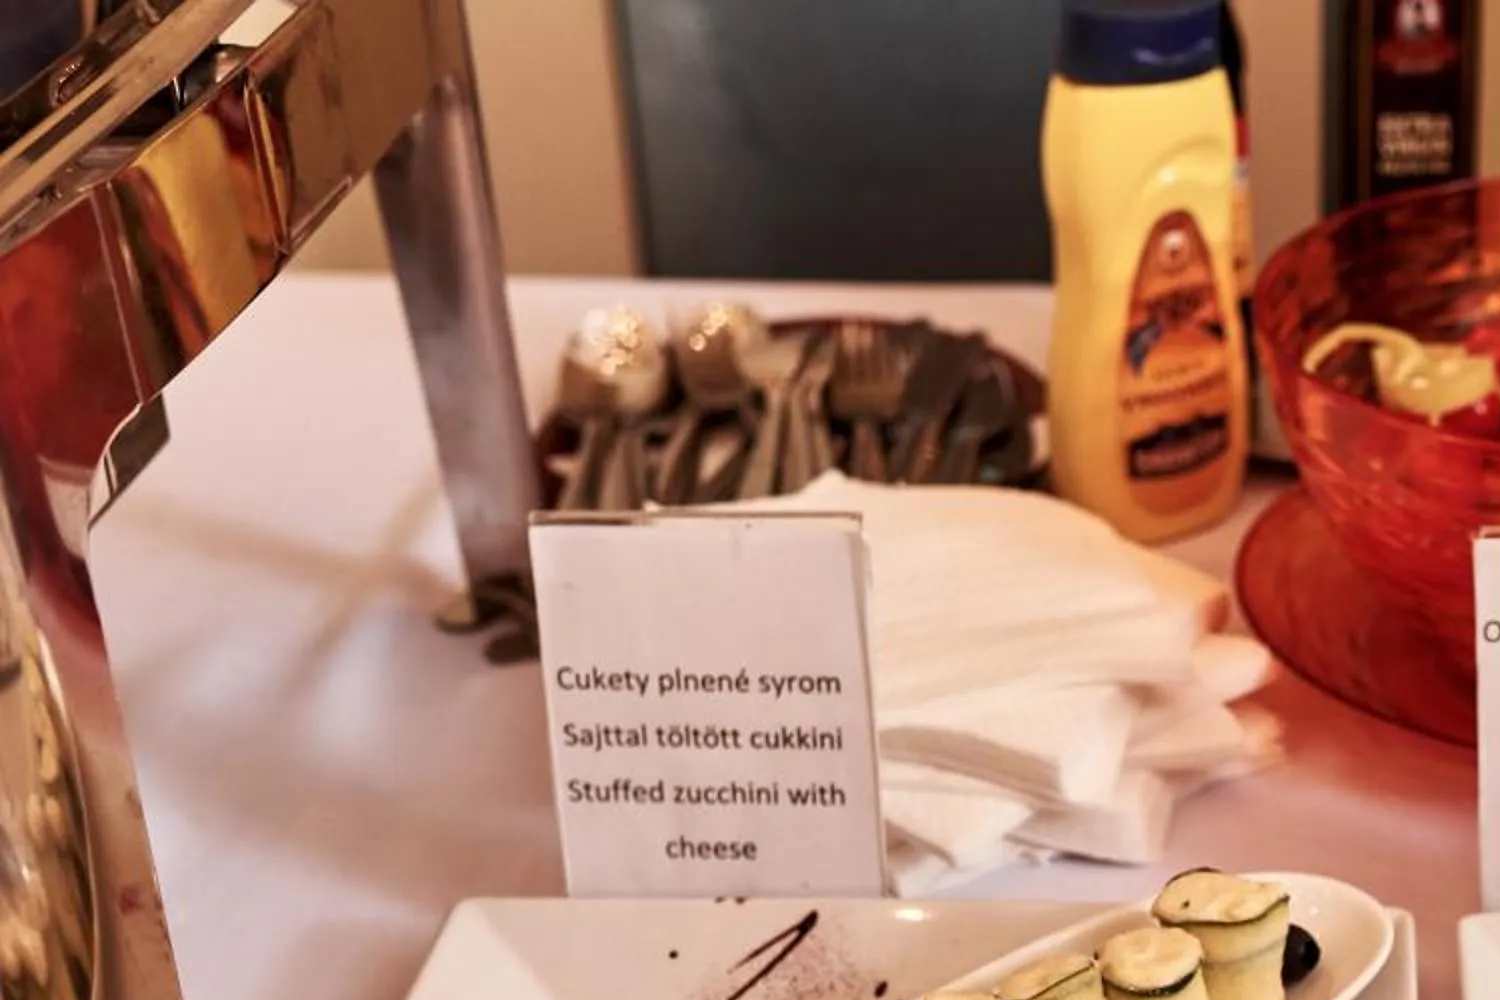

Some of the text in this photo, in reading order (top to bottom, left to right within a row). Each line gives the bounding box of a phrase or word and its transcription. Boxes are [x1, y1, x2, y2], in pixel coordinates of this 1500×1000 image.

[557, 666, 842, 698] Cukety plnené syrom
[563, 723, 843, 751] Sajttal töltött cukkini
[567, 779, 847, 807] Stuffed zucchini with
[665, 836, 758, 861] cheese
